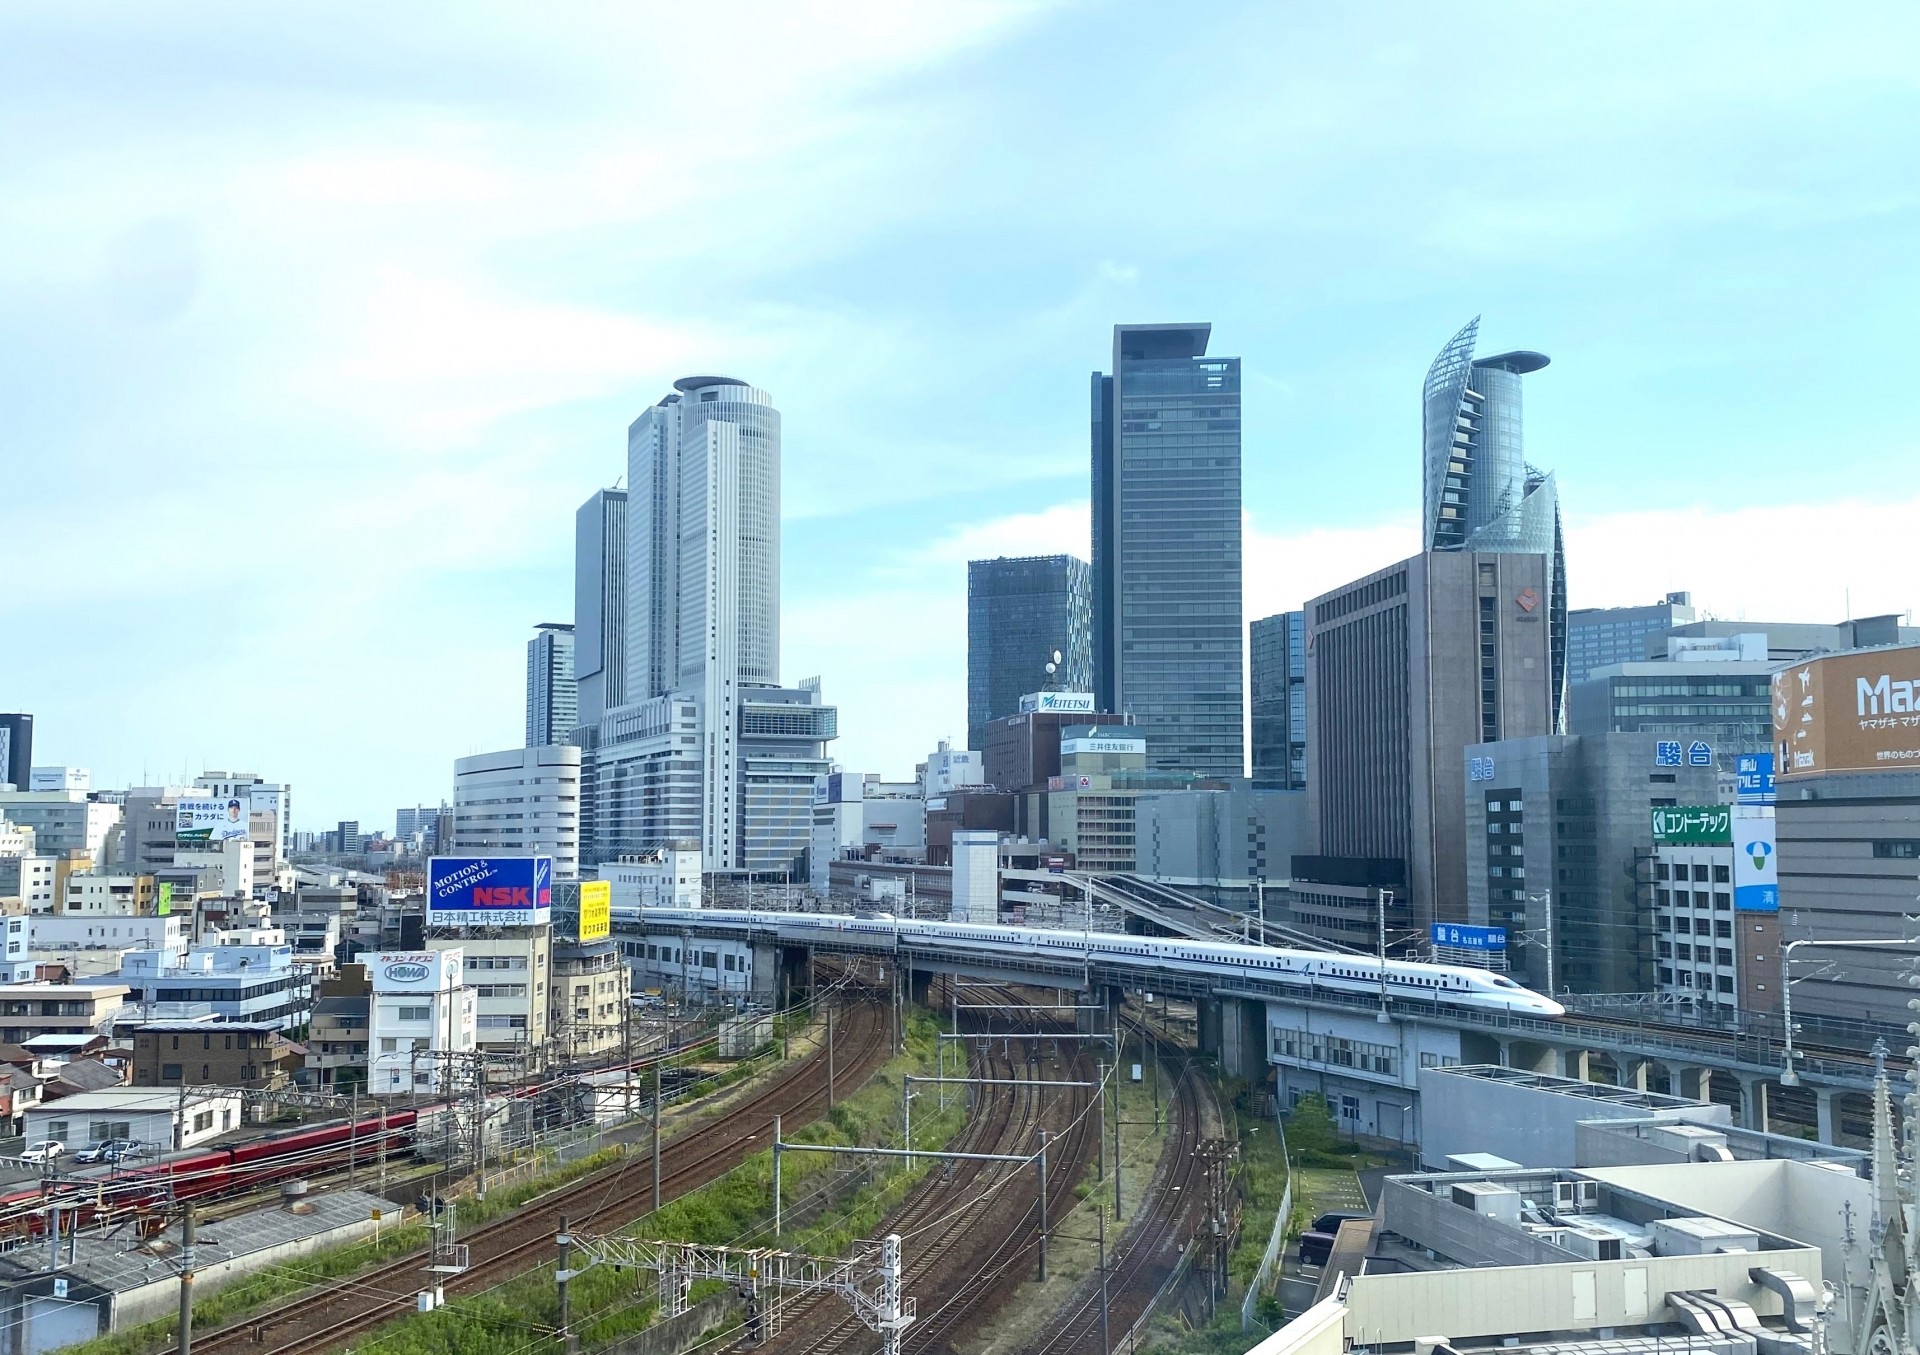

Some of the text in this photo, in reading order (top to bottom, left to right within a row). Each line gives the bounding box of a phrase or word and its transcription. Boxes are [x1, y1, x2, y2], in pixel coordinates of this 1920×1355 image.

[1042, 693, 1091, 709] MEITETSU
[1859, 718, 1898, 731] ヤマザキ
[1089, 743, 1134, 752] 三井住友銀行
[1655, 740, 1713, 767] 駿台
[1470, 756, 1495, 782] 駿台
[1666, 812, 1728, 834] コンドーテック
[433, 859, 489, 890] MOTION &
[472, 886, 532, 907] NSK
[1762, 889, 1778, 905] 清
[432, 910, 529, 923] 日本精工株式会社
[388, 966, 426, 978] HOWA
